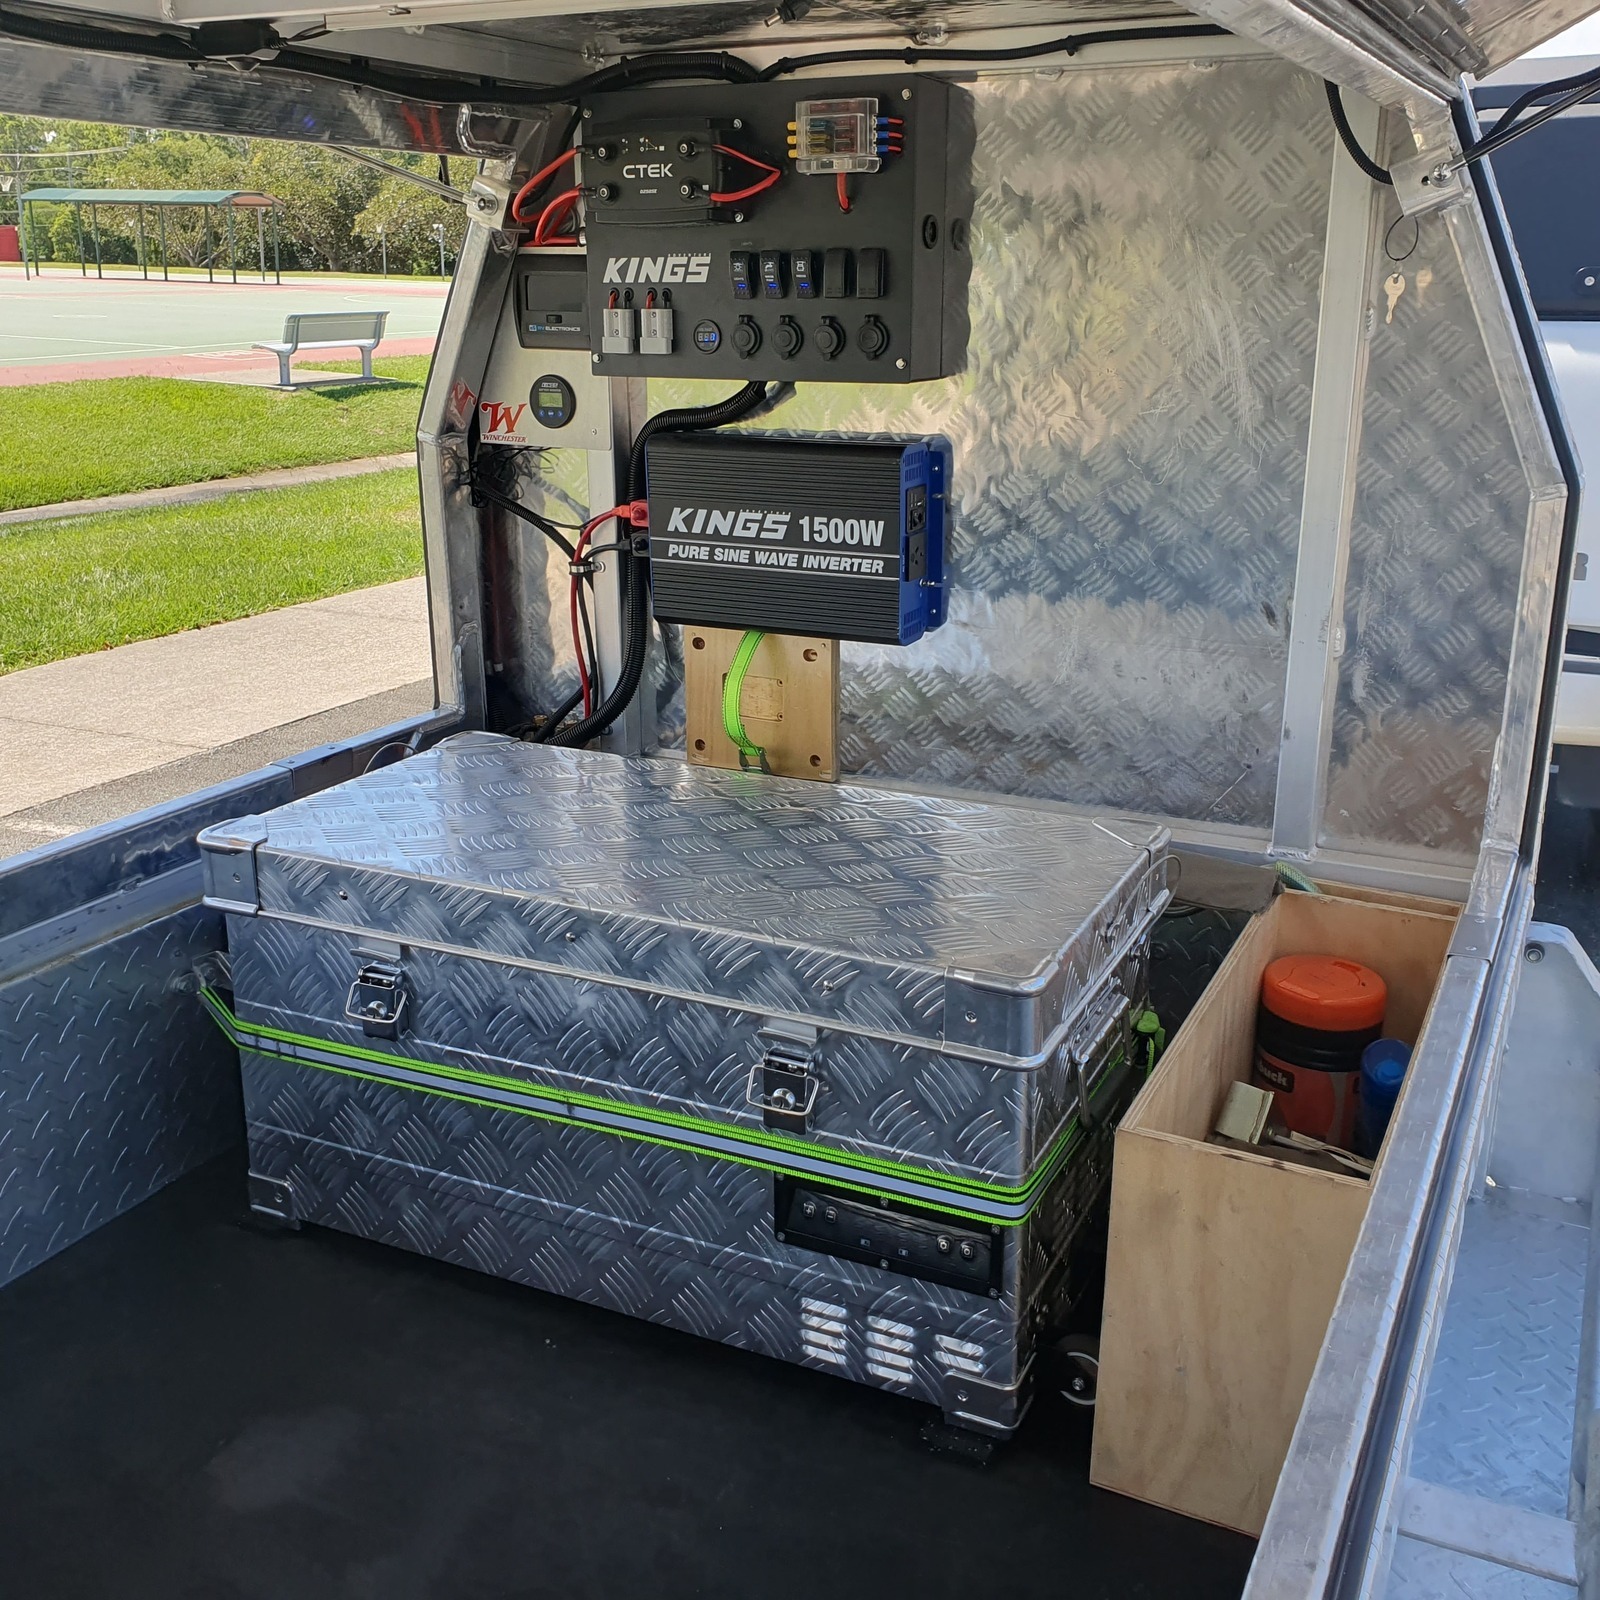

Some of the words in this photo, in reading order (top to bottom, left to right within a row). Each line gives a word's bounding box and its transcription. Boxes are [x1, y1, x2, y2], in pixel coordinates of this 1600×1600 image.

[622, 163, 674, 179] CTEK
[602, 256, 711, 284] KINGS
[481, 433, 527, 443] WINCHESTER
[666, 507, 792, 541] KINGS
[799, 515, 885, 547] 1500W
[668, 543, 710, 560] PURE
[713, 547, 751, 564] SINE
[754, 550, 799, 567] WAVE
[802, 554, 885, 574] INVERTER
[1255, 1058, 1288, 1086] buck
